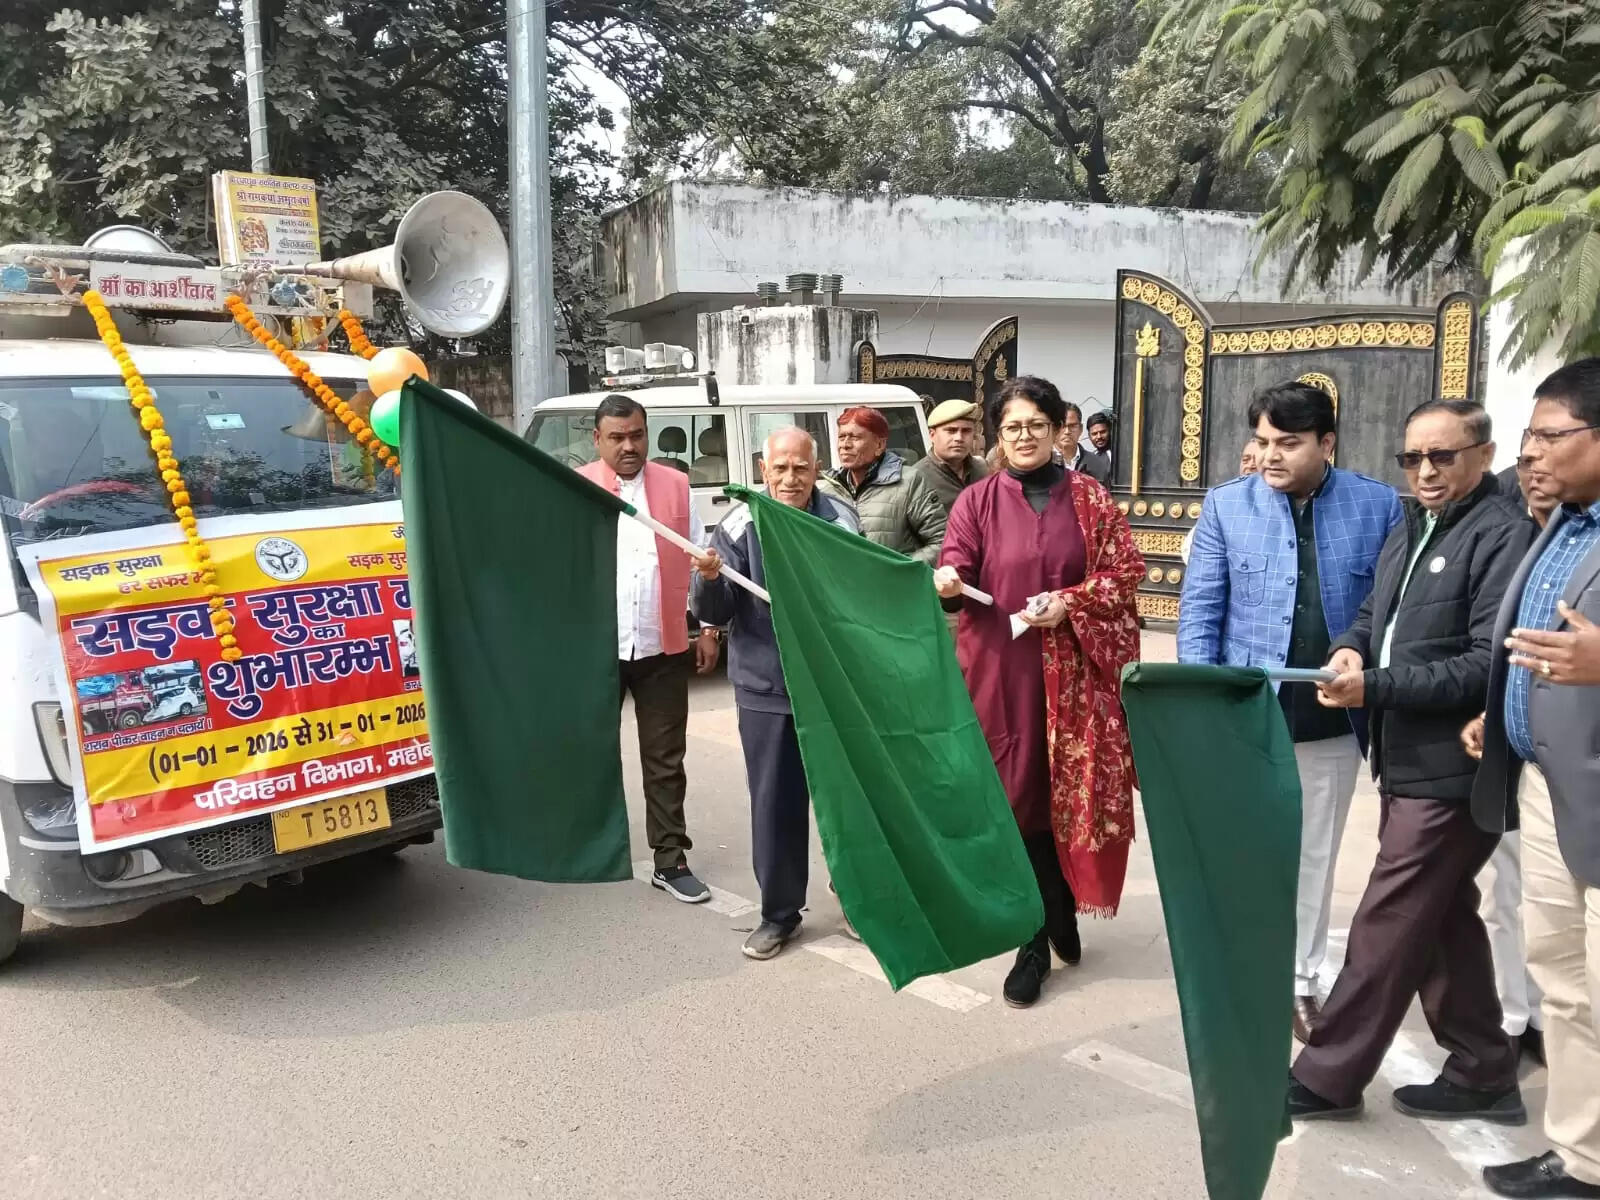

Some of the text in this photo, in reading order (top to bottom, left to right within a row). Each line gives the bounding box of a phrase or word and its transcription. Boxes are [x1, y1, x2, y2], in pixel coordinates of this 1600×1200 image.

[124, 280, 145, 297] का
[59, 555, 163, 581] सड़क सुरक्षा
[347, 554, 384, 569] सड़क
[118, 582, 142, 594] हर
[146, 574, 189, 590] सफर
[246, 582, 383, 646] सुरक्षा
[312, 624, 345, 640] का
[208, 635, 392, 719] शुभारम्भ
[112, 733, 139, 746] पीकर
[140, 732, 166, 744] वाहन
[246, 729, 289, 756] 2026
[292, 718, 312, 746] से
[318, 720, 335, 742] 31
[358, 711, 375, 733] 01
[396, 702, 425, 725] 2026
[193, 741, 432, 811] परिवहन विभाग, महोब
[301, 798, 378, 838] T 5813
